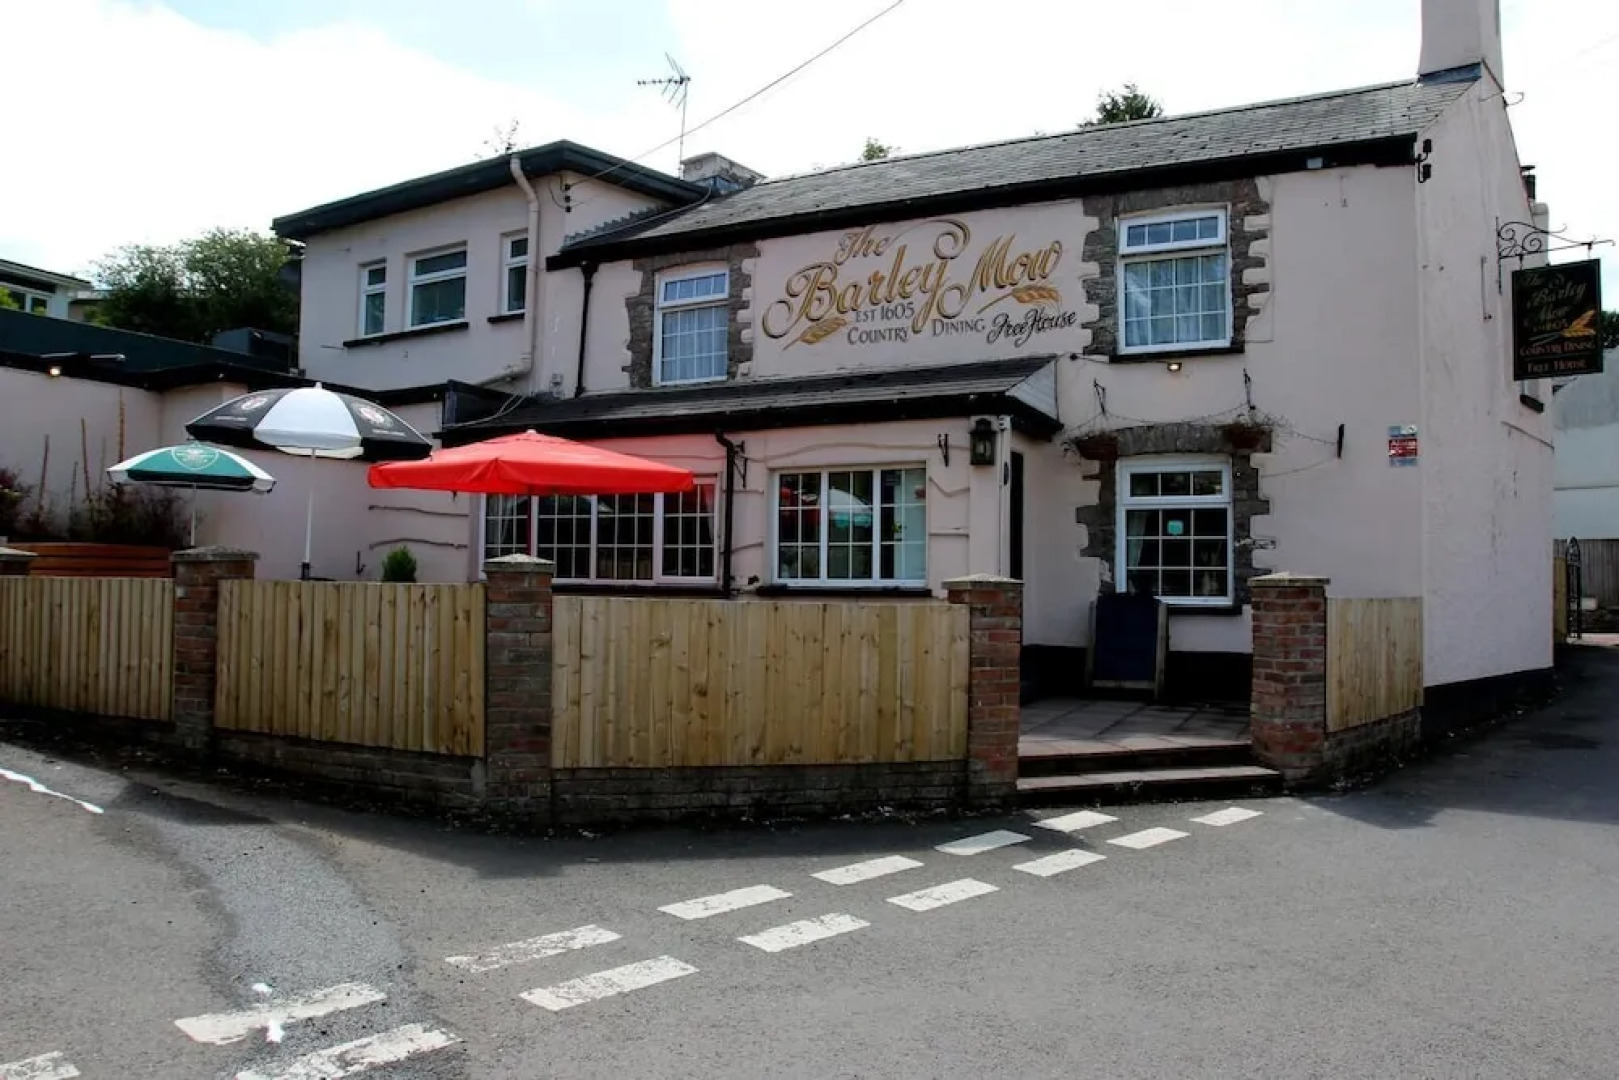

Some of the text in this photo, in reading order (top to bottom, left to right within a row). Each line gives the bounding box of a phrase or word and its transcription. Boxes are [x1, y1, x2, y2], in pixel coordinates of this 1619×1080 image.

[835, 224, 893, 265] The
[762, 228, 1063, 338] Barley Mow
[855, 302, 915, 323] EST 1605
[847, 318, 985, 346] COUNTRY DINING
